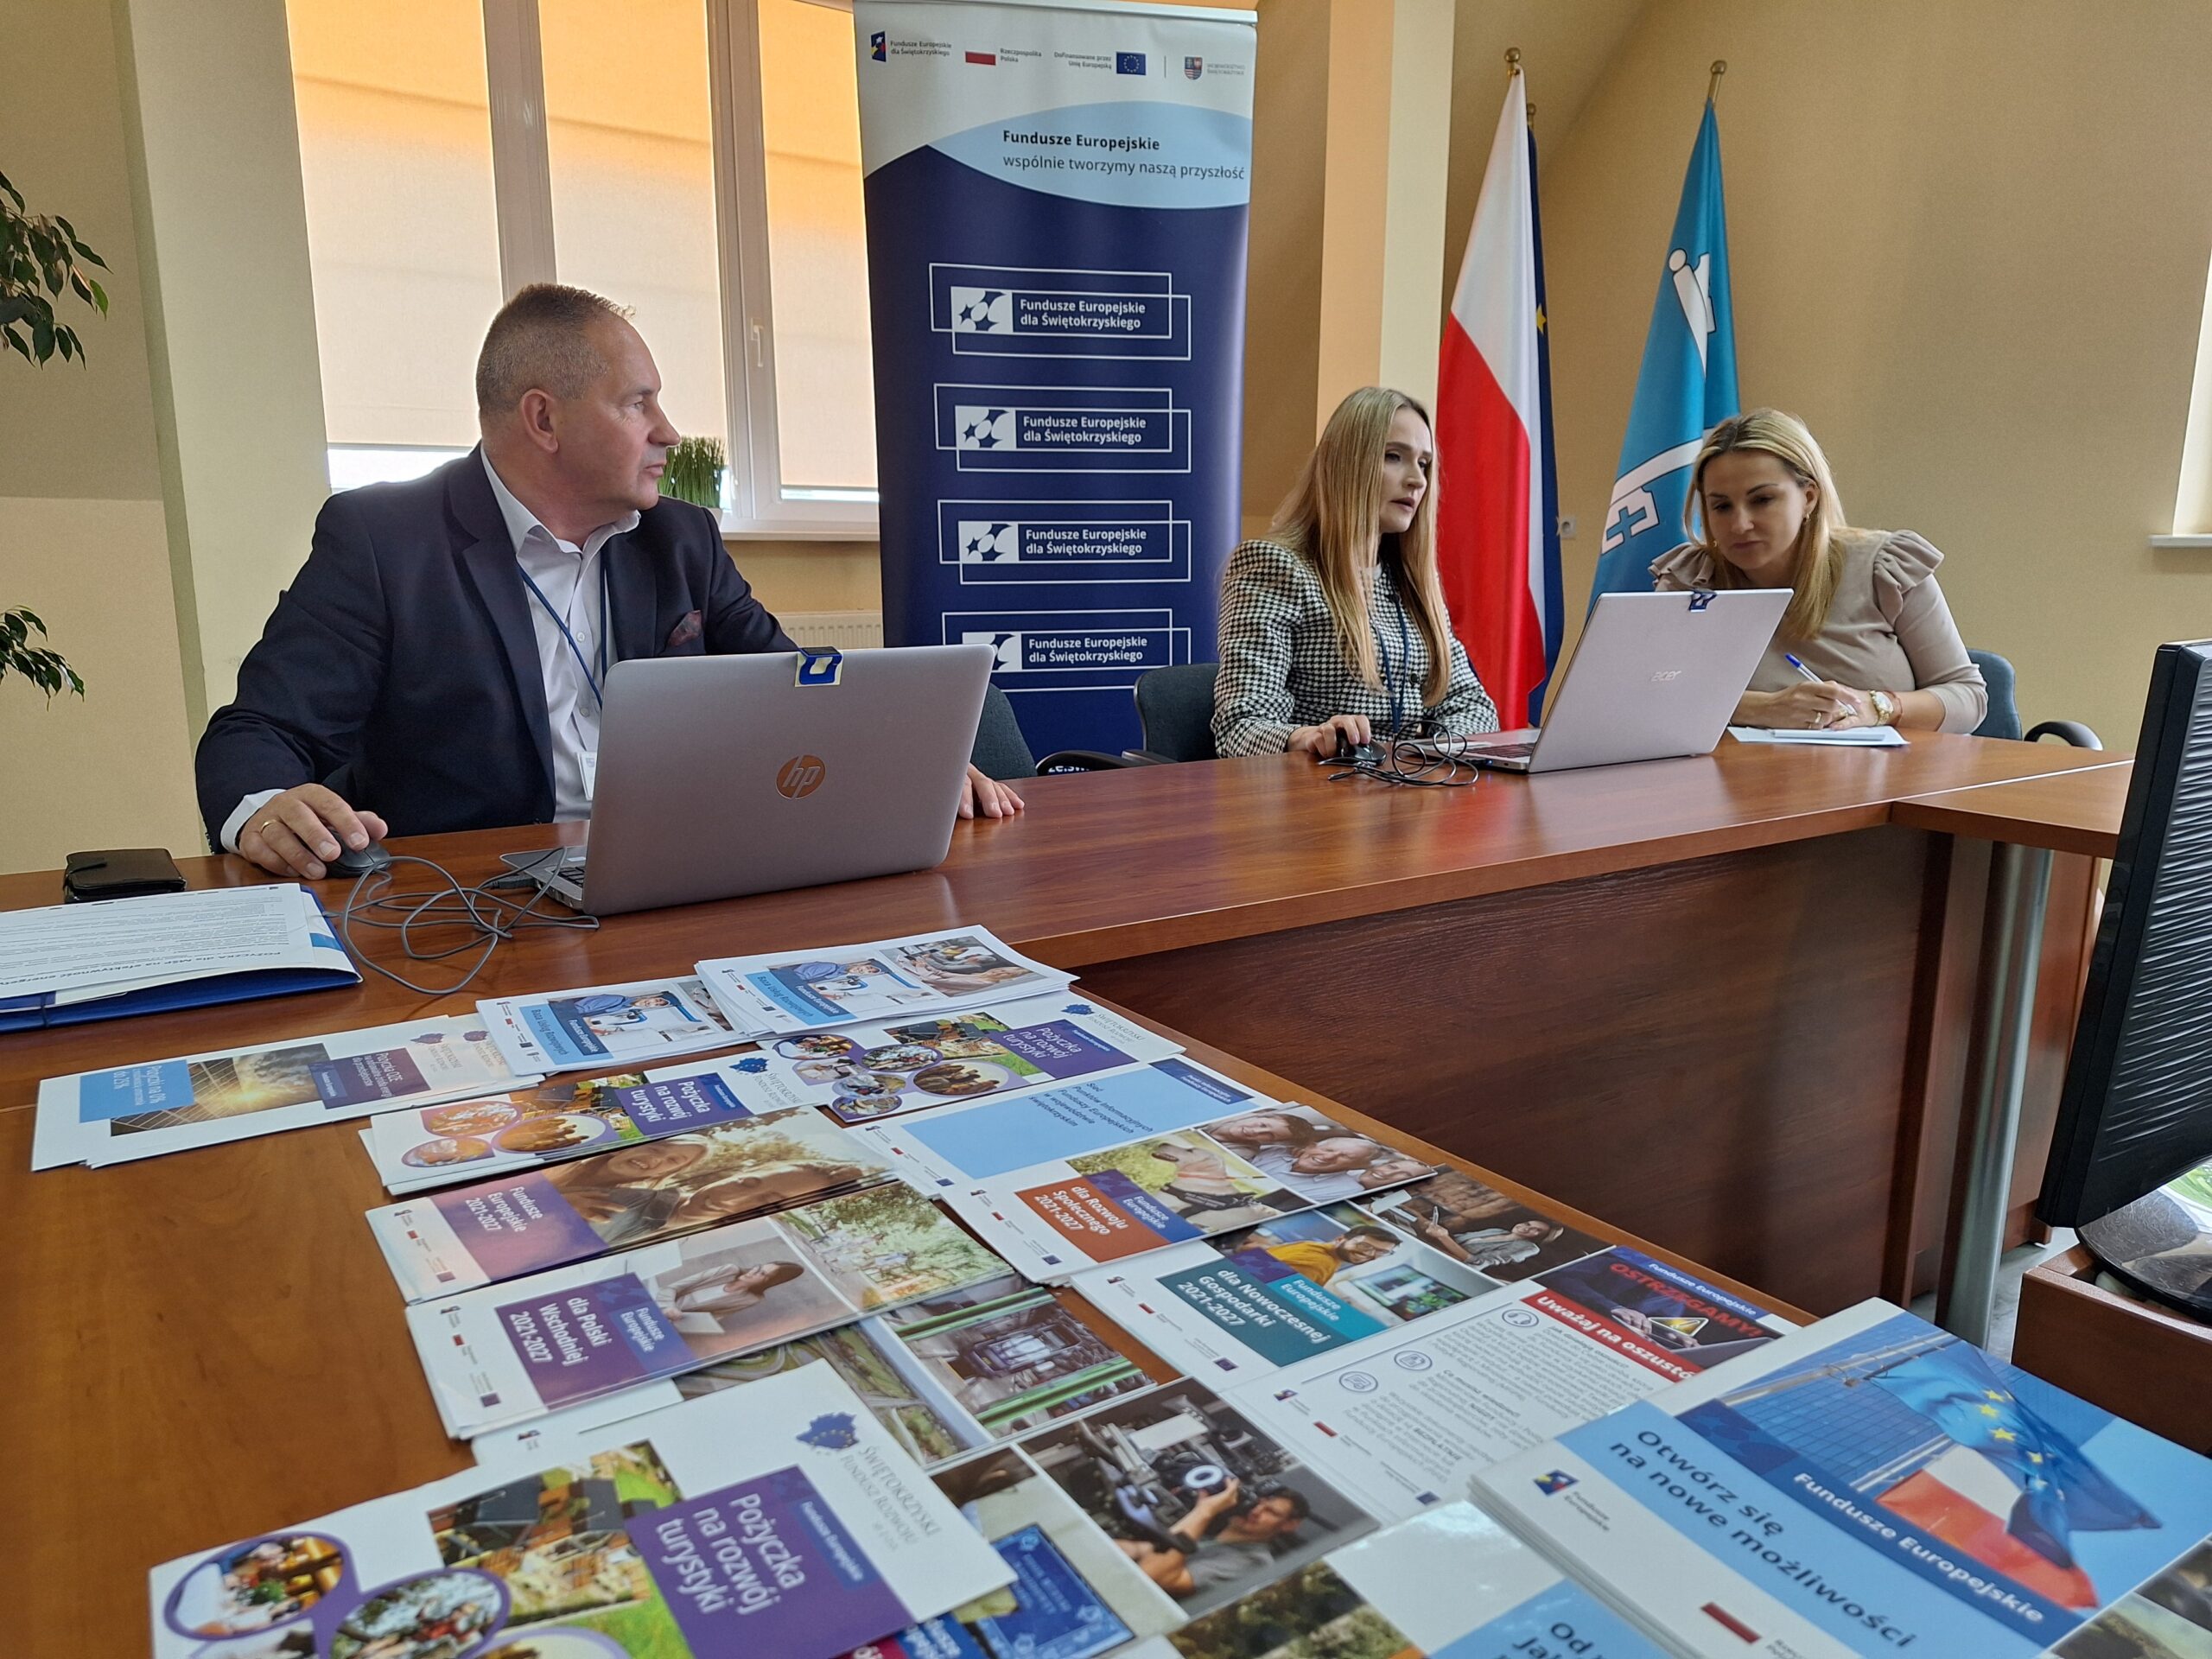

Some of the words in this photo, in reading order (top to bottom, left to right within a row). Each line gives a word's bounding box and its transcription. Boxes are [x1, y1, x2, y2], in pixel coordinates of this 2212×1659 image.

[1002, 129, 1072, 147] Fundusze
[1076, 133, 1160, 152] Europejskie
[1002, 154, 1065, 172] wspólnie
[1068, 157, 1136, 176] tworzymy
[1139, 162, 1176, 178] naszą
[1180, 163, 1245, 181] przyszłość
[1020, 298, 1077, 312] Fundusze
[1078, 300, 1146, 316] Europejskie
[1020, 313, 1039, 327] dla
[1041, 311, 1141, 332] Świętokrzyskiego
[1023, 416, 1078, 429] Fundusze
[1081, 416, 1147, 431] Europejskie
[1023, 429, 1041, 442] dla
[1044, 429, 1142, 445] Świętokrzyskiego
[1026, 529, 1080, 541] Fundusze
[1082, 528, 1147, 543] Europejskie
[1026, 542, 1044, 554] dla
[1046, 540, 1142, 556] Świętokrzyskiego
[1028, 637, 1082, 649] Fundusze
[1084, 636, 1147, 650] Europejskie
[1028, 650, 1047, 662] dla
[1049, 649, 1143, 664] Świętokrzyskiego
[1650, 670, 1682, 683] acer
[779, 755, 823, 799] hp
[1002, 1033, 1050, 1059] turystyki
[1019, 1031, 1036, 1042] na
[1035, 1039, 1071, 1059] rozwój
[1036, 1027, 1082, 1054] Pożyczka
[654, 1085, 671, 1099] na
[664, 1098, 692, 1121] rozwój
[678, 1080, 711, 1114] Pożyczka
[1086, 1082, 1105, 1093] Sieć
[631, 1089, 666, 1122] turystyki
[1050, 1096, 1096, 1125] województwie
[1058, 1089, 1092, 1109] Funduszy
[1088, 1107, 1135, 1135] Europejskich
[1072, 1085, 1103, 1104] Punktów
[1100, 1102, 1154, 1134] Informacyjnych
[487, 1192, 527, 1233] Europejskie
[509, 1185, 544, 1220] Fundusze
[1033, 1194, 1085, 1231] 2021-2027
[1052, 1190, 1111, 1236] Społecznego
[1071, 1185, 1089, 1199] dla
[1086, 1197, 1129, 1230] Rozwoju
[1122, 1198, 1166, 1230] Europejskie
[1134, 1195, 1170, 1221] Fundusze
[567, 1297, 588, 1317] dla
[1176, 1281, 1247, 1327] 2021-2027
[1198, 1274, 1278, 1328] Gospodarki
[1217, 1268, 1241, 1287] dla
[1241, 1282, 1332, 1345] Nowoczesnej
[1280, 1282, 1340, 1322] Europejskie
[1294, 1279, 1342, 1311] Fundusze
[1609, 1262, 1767, 1338] OSTRZEGAMY!
[1648, 1262, 1697, 1287] Fundusze
[1694, 1284, 1758, 1317] Europejskie
[508, 1310, 554, 1363] 2021-2027
[538, 1302, 590, 1367] Wschodniej
[576, 1313, 613, 1347] Polski
[620, 1312, 655, 1352] Europejskie
[636, 1306, 666, 1341] Fundusze
[1536, 1295, 1598, 1332] Uważaj
[1596, 1326, 1623, 1344] na
[1621, 1341, 1695, 1380] oszustó
[859, 1445, 942, 1536] ŚWIĘTOKRZYSKI
[1637, 1429, 1739, 1505] Otwórz
[1738, 1498, 1785, 1536] się
[728, 1492, 807, 1591] Pożyczka
[799, 1500, 832, 1541] Fundusze
[823, 1535, 864, 1583] Europejskie
[1609, 1440, 1647, 1471] na
[1648, 1463, 1729, 1529] nowe
[1730, 1528, 1919, 1649] możliwości
[1793, 1471, 1898, 1540] Fundusze
[1897, 1534, 2046, 1625] Europejskie
[655, 1517, 736, 1615] turystyki
[693, 1507, 728, 1540] na
[715, 1533, 782, 1616] rozwój
[1551, 1622, 1594, 1655] Od
